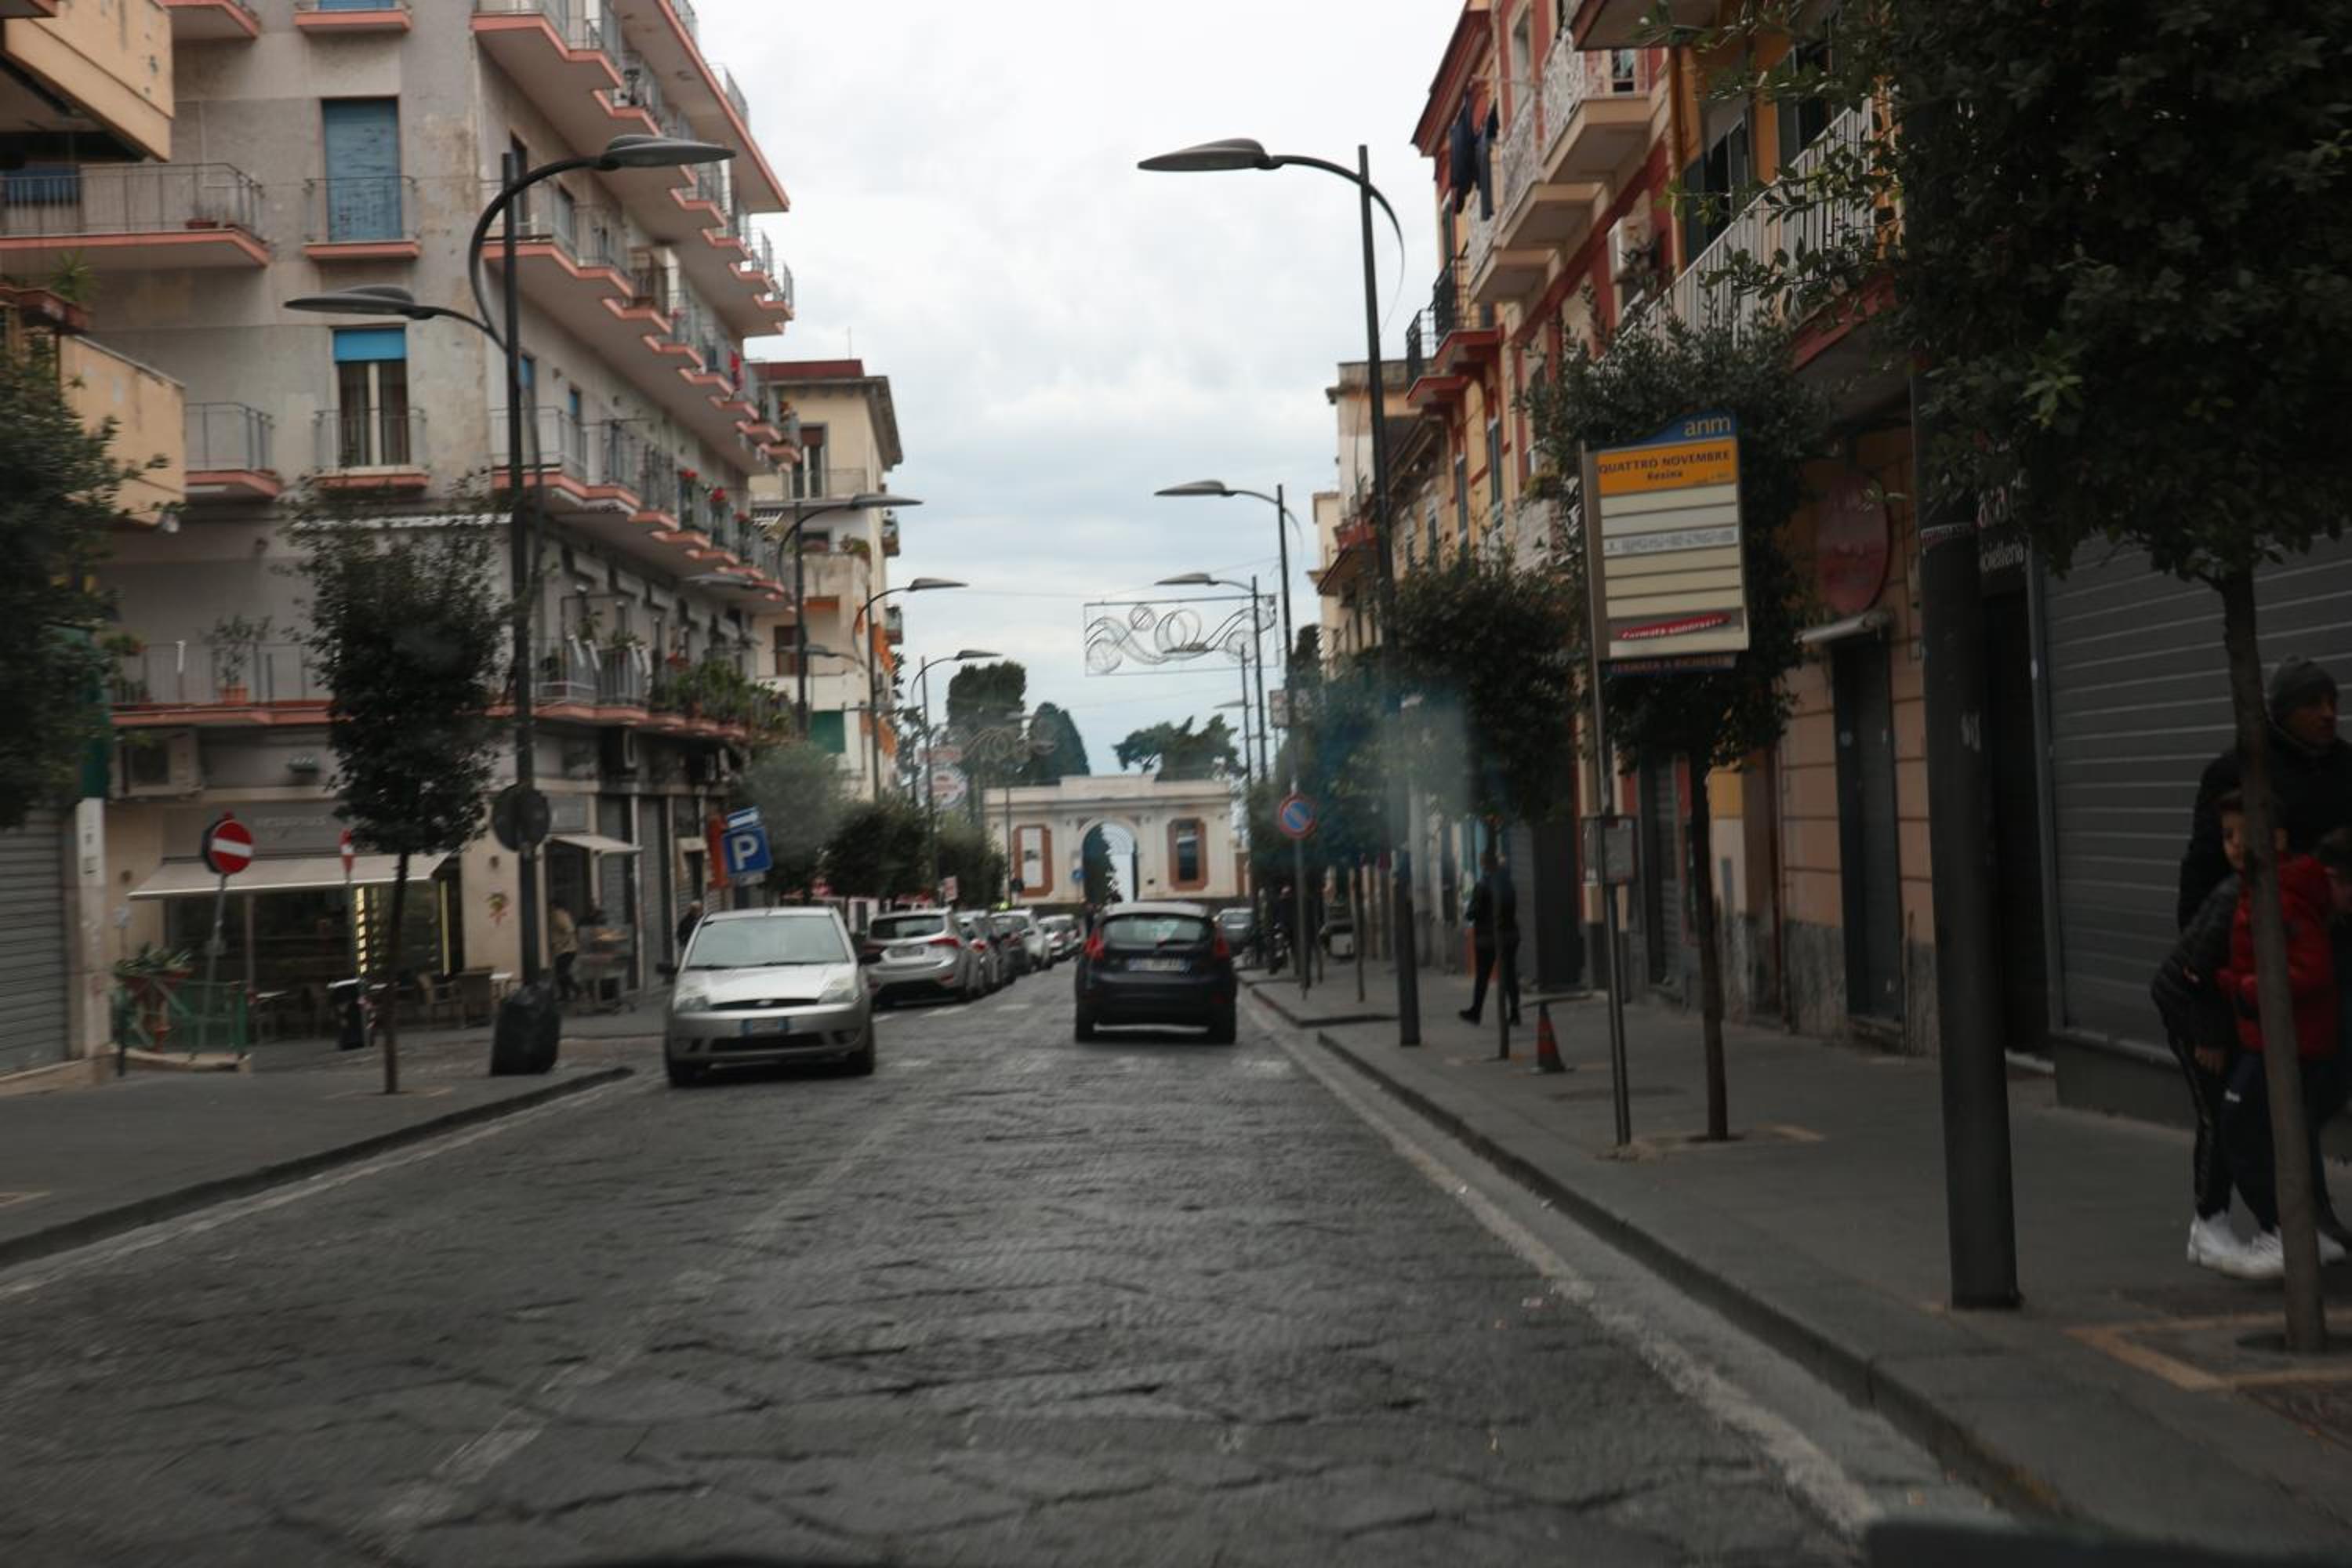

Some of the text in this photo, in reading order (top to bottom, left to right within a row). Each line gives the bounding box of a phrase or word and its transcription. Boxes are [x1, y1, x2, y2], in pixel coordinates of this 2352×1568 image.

[1684, 416, 1731, 437] anm
[1599, 450, 1731, 474] QUATTRO NOVEMBRE
[731, 834, 759, 870] P
